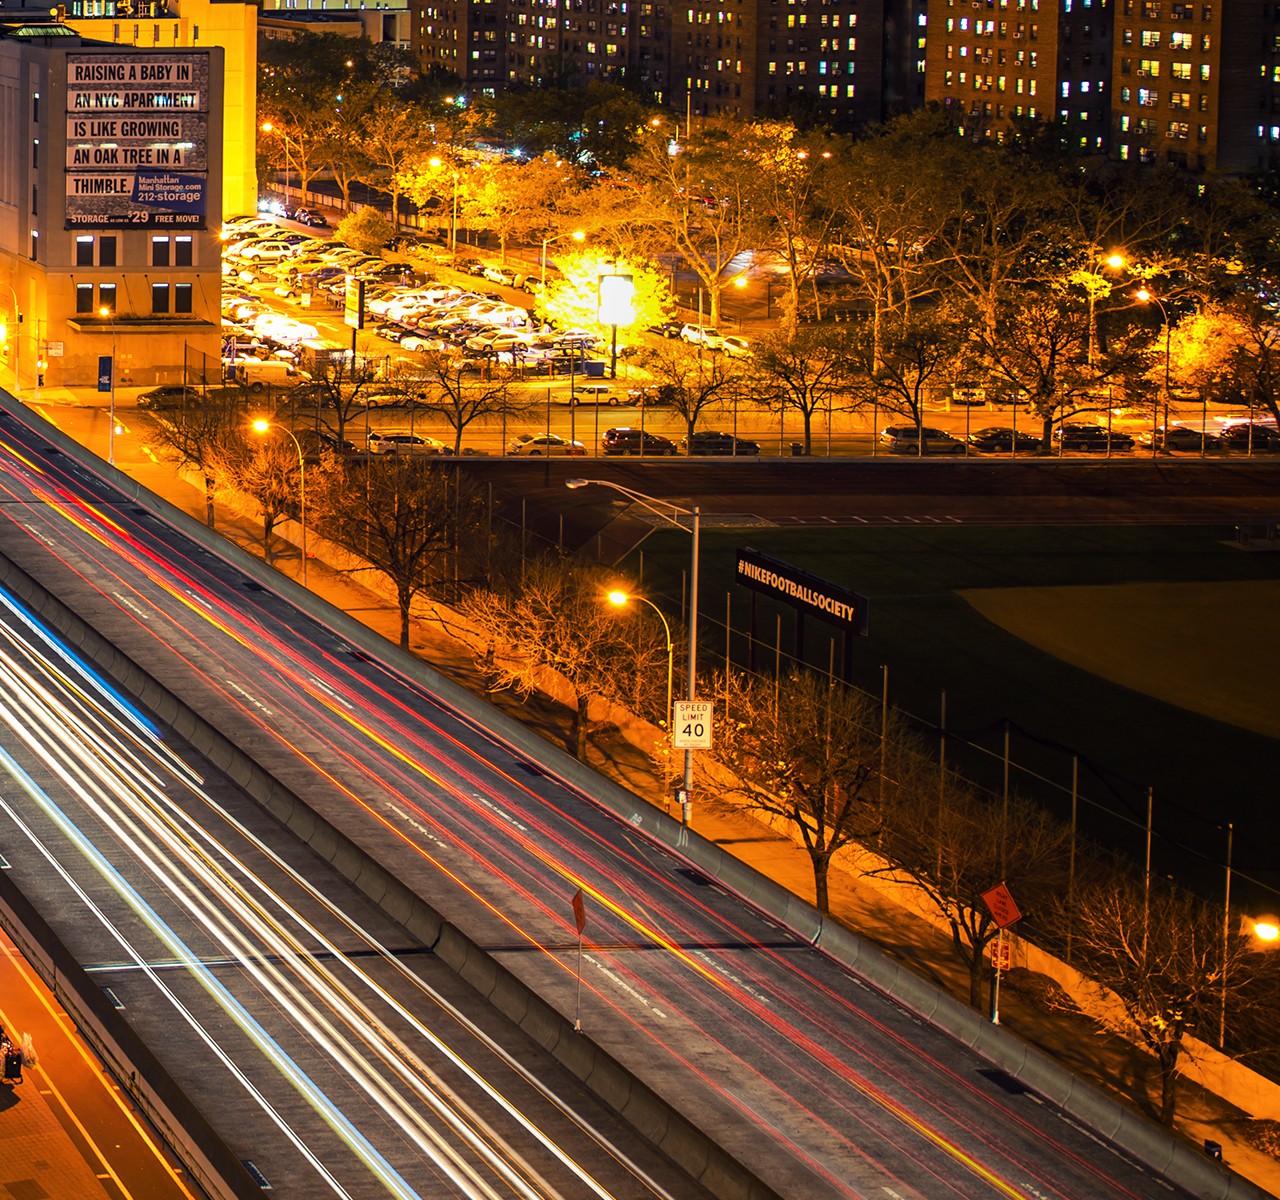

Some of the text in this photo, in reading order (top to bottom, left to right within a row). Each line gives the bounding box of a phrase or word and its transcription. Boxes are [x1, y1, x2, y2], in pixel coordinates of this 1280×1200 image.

[75, 65, 189, 81] RAISING A BABY IN
[75, 93, 196, 108] AN NYC APARTMENT
[74, 121, 179, 137] IS LIKE GROWING
[73, 149, 181, 164] AN OAK TREE IN A
[73, 178, 131, 194] THIMBLE.
[139, 175, 180, 184] Manhattan
[155, 184, 202, 192] Storage.com
[71, 214, 109, 223] STORAGE
[127, 210, 149, 223] $29
[155, 215, 174, 223] FREE
[175, 215, 200, 223] MOVE!
[738, 559, 855, 622] #NIKEFOOTBALLSOCIETY
[682, 713, 704, 721] LIMIT
[682, 723, 704, 737] 40
